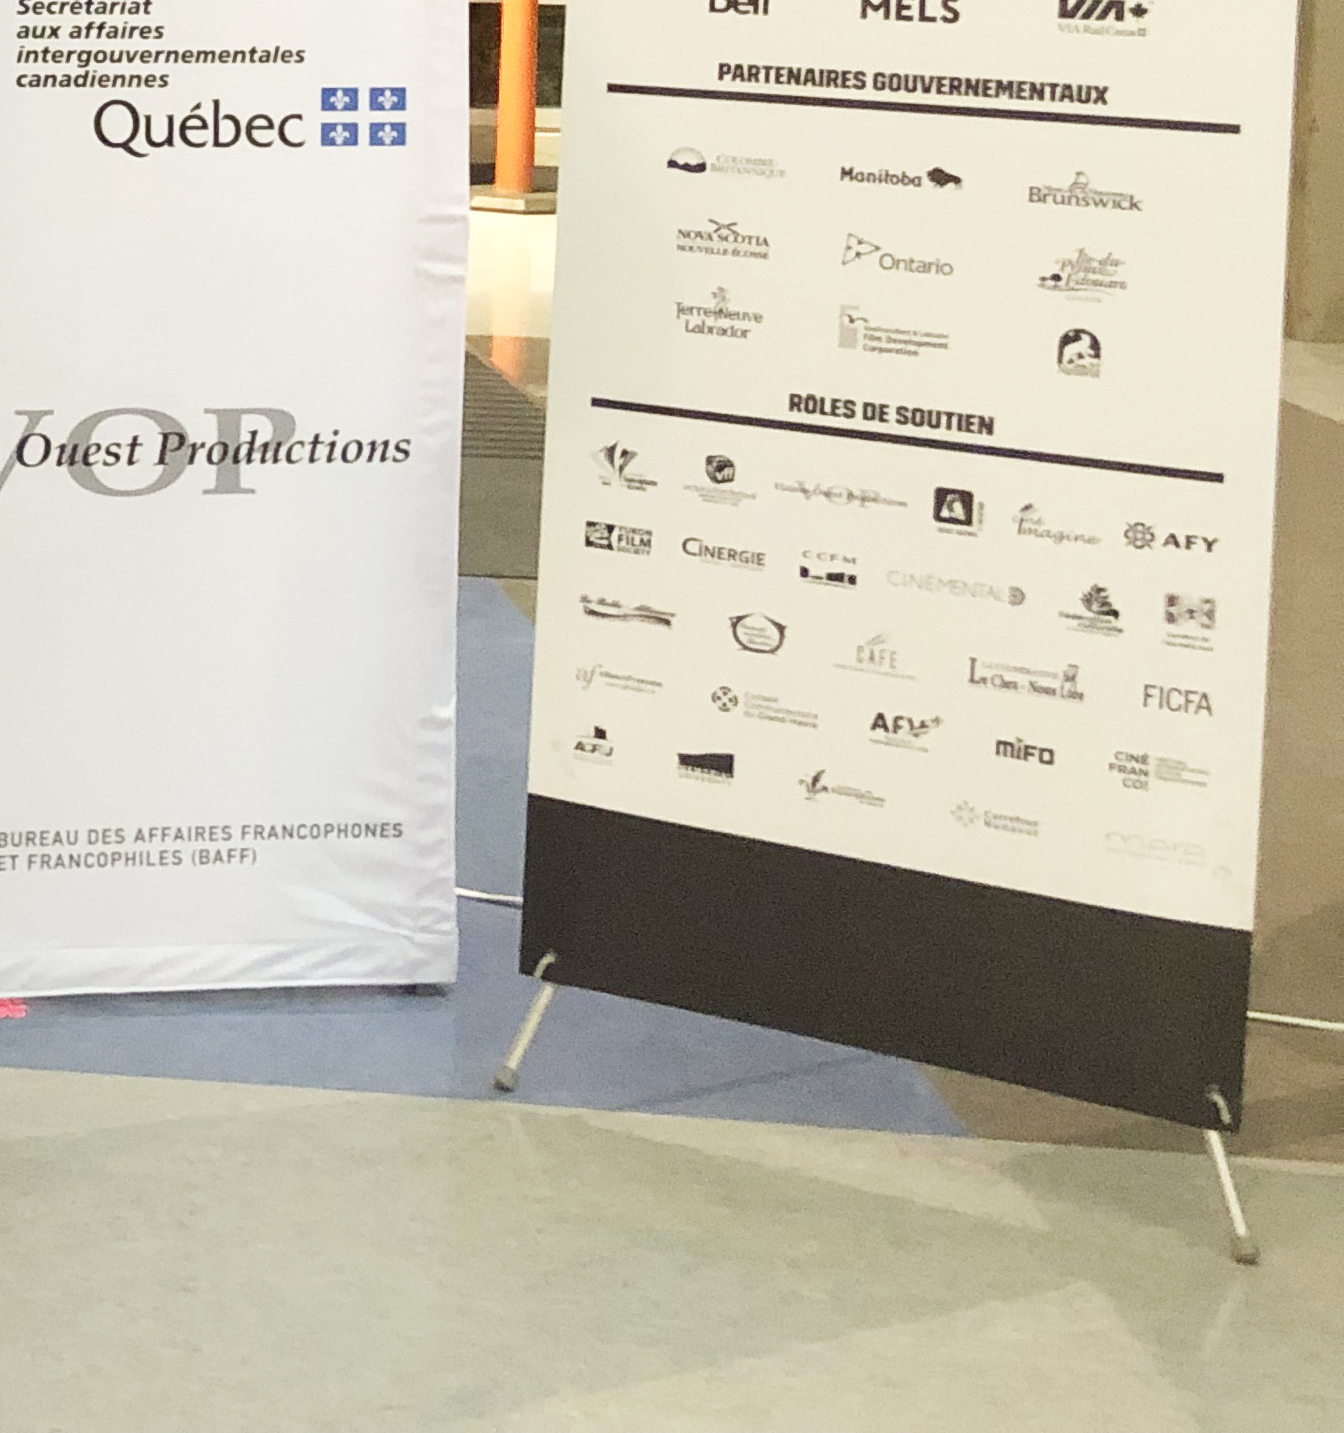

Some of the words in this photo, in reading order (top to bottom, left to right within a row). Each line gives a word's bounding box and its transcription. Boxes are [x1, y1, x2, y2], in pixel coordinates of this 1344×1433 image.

[16, 23, 59, 40] aux
[69, 20, 165, 40] affaires
[16, 44, 305, 69] intergouvernementales
[16, 69, 169, 89] canadiennes
[717, 62, 868, 92] PARTENAIRES
[873, 71, 1109, 107] GOUVERNEMENTAUX
[93, 99, 306, 158] Québec
[840, 166, 922, 187] Manitoba
[1028, 186, 1143, 211] Brunswick
[677, 229, 712, 243] NOVA
[716, 232, 770, 247] SCOTIA
[879, 253, 955, 276] Ontario
[685, 319, 751, 339] Labrador
[789, 392, 857, 420] RÔLES
[863, 399, 889, 422] DE
[896, 404, 995, 436] SOUTIEN
[16, 433, 143, 467] Ouest
[157, 430, 411, 467] Productions
[617, 533, 652, 548] FILM
[1162, 532, 1220, 553] AFY
[1142, 684, 1213, 716] FICFA
[87, 827, 127, 846] DES
[134, 825, 233, 845] AFFAIRES
[240, 821, 404, 841] FRANCOPHONES
[27, 849, 183, 869] FRANCOPHILES
[191, 847, 257, 866] (BAFF)
